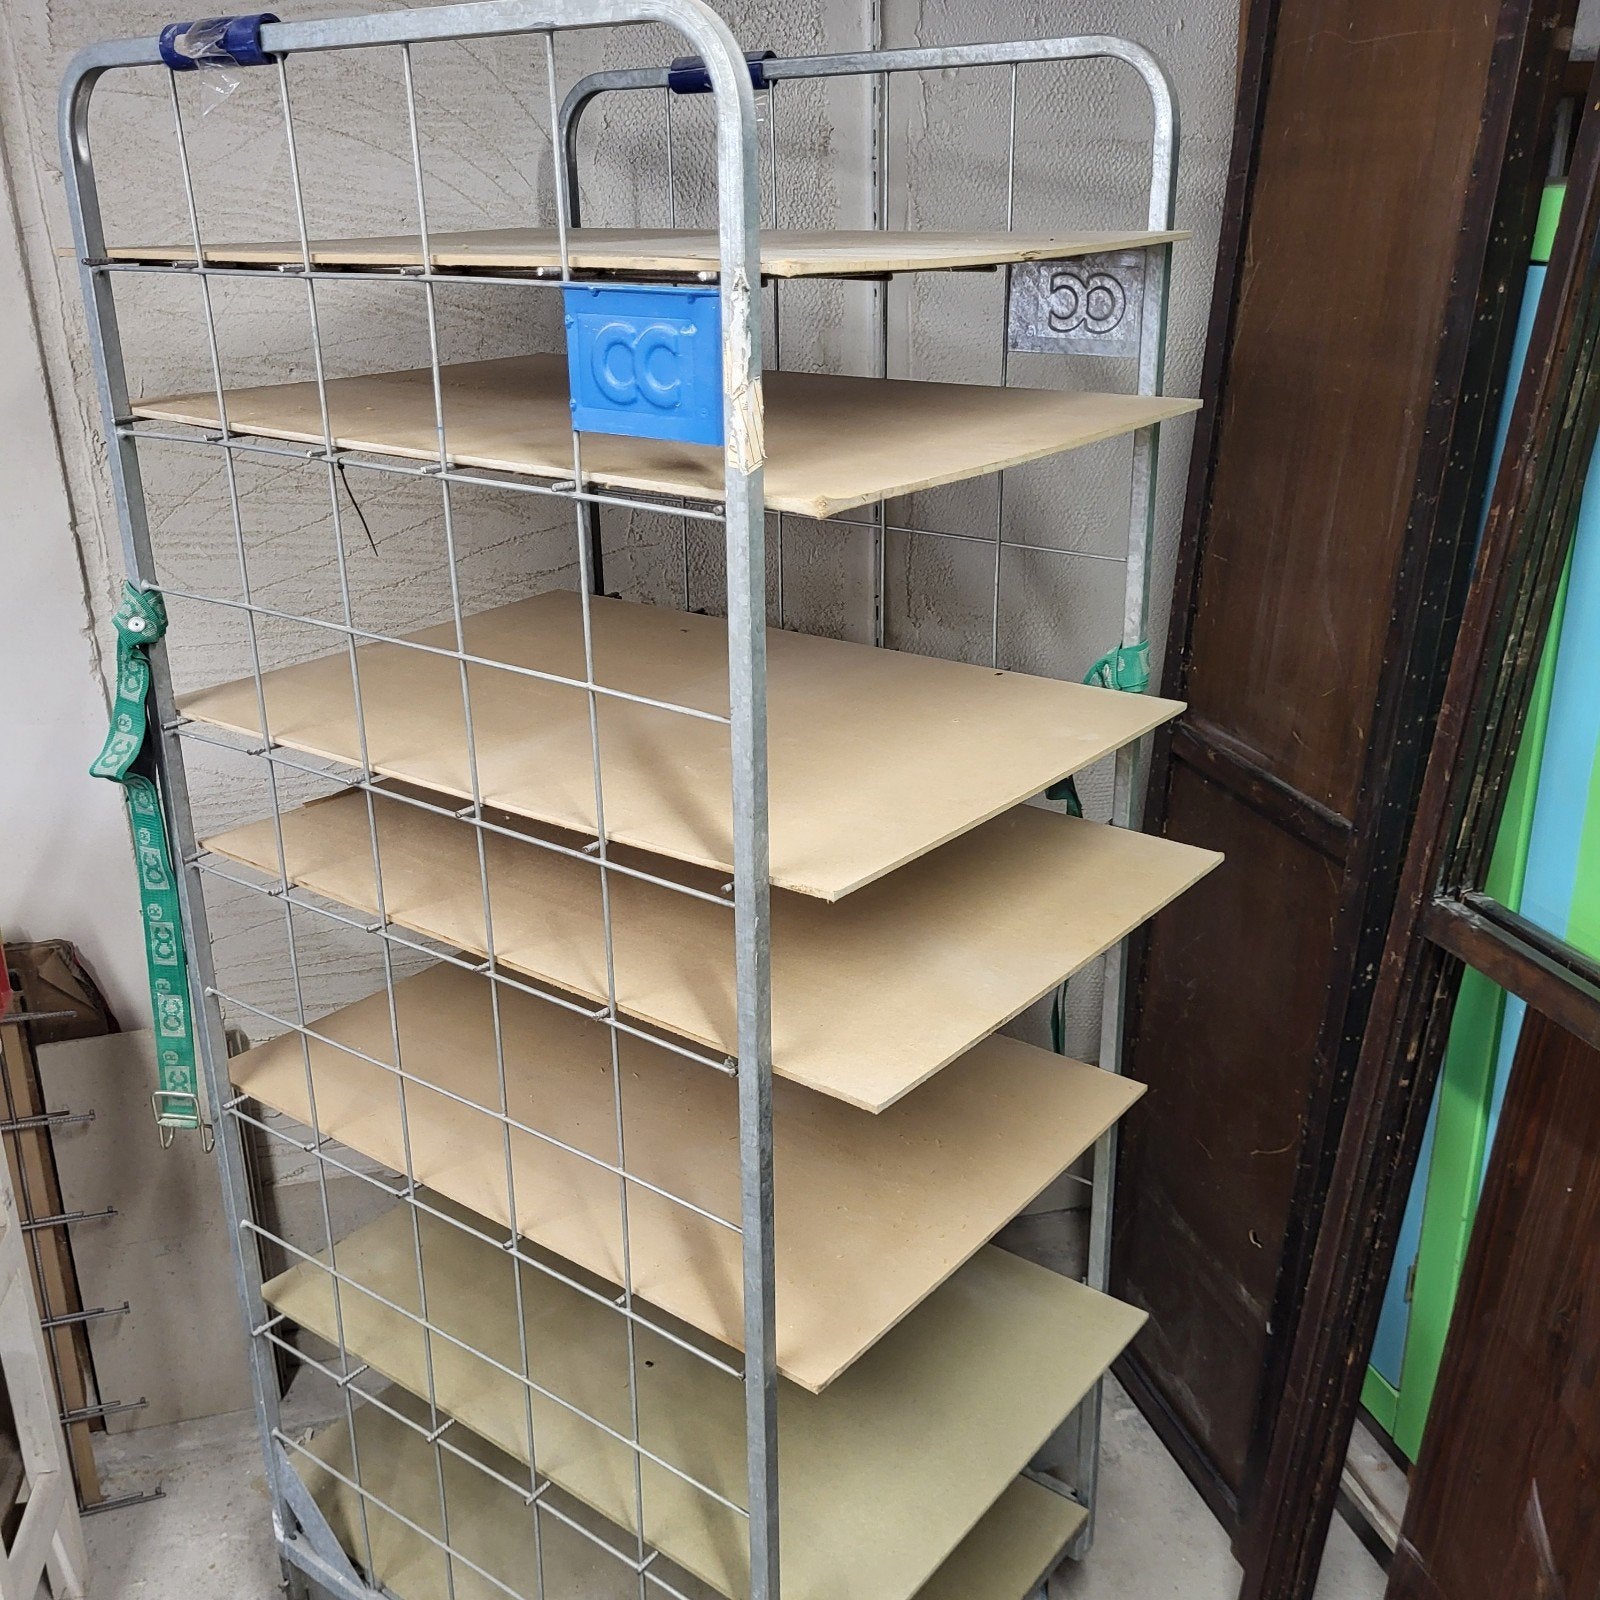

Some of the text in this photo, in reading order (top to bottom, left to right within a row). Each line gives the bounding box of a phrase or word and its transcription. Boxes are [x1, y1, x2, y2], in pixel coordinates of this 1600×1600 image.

[591, 322, 681, 410] CC
[101, 739, 132, 769] CC
[143, 852, 166, 884] CC
[153, 927, 174, 959] CC
[162, 1000, 181, 1031] CC
